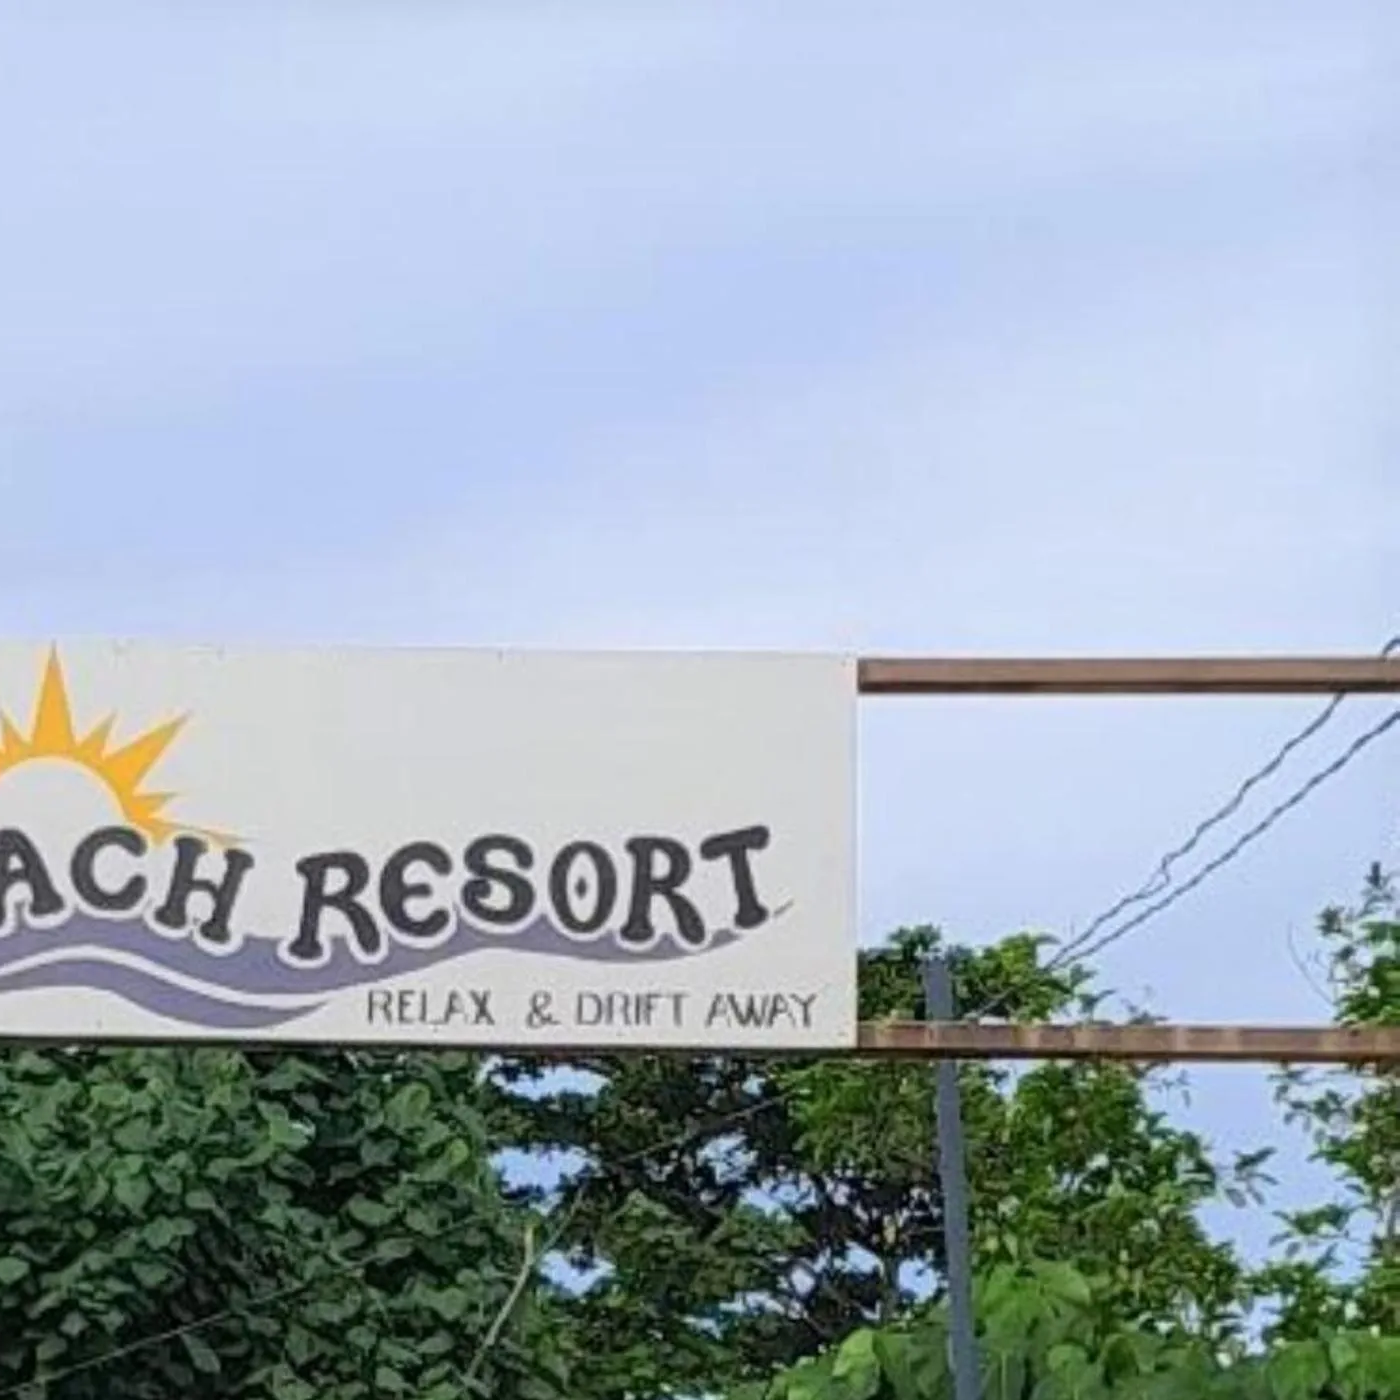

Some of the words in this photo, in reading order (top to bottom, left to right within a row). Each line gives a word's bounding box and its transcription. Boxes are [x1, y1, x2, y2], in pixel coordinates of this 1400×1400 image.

[286, 825, 770, 960] RESORT
[366, 989, 496, 1027] RELAX
[525, 991, 562, 1030] &
[576, 991, 688, 1028] DRIFT
[703, 992, 818, 1029] AWAY
